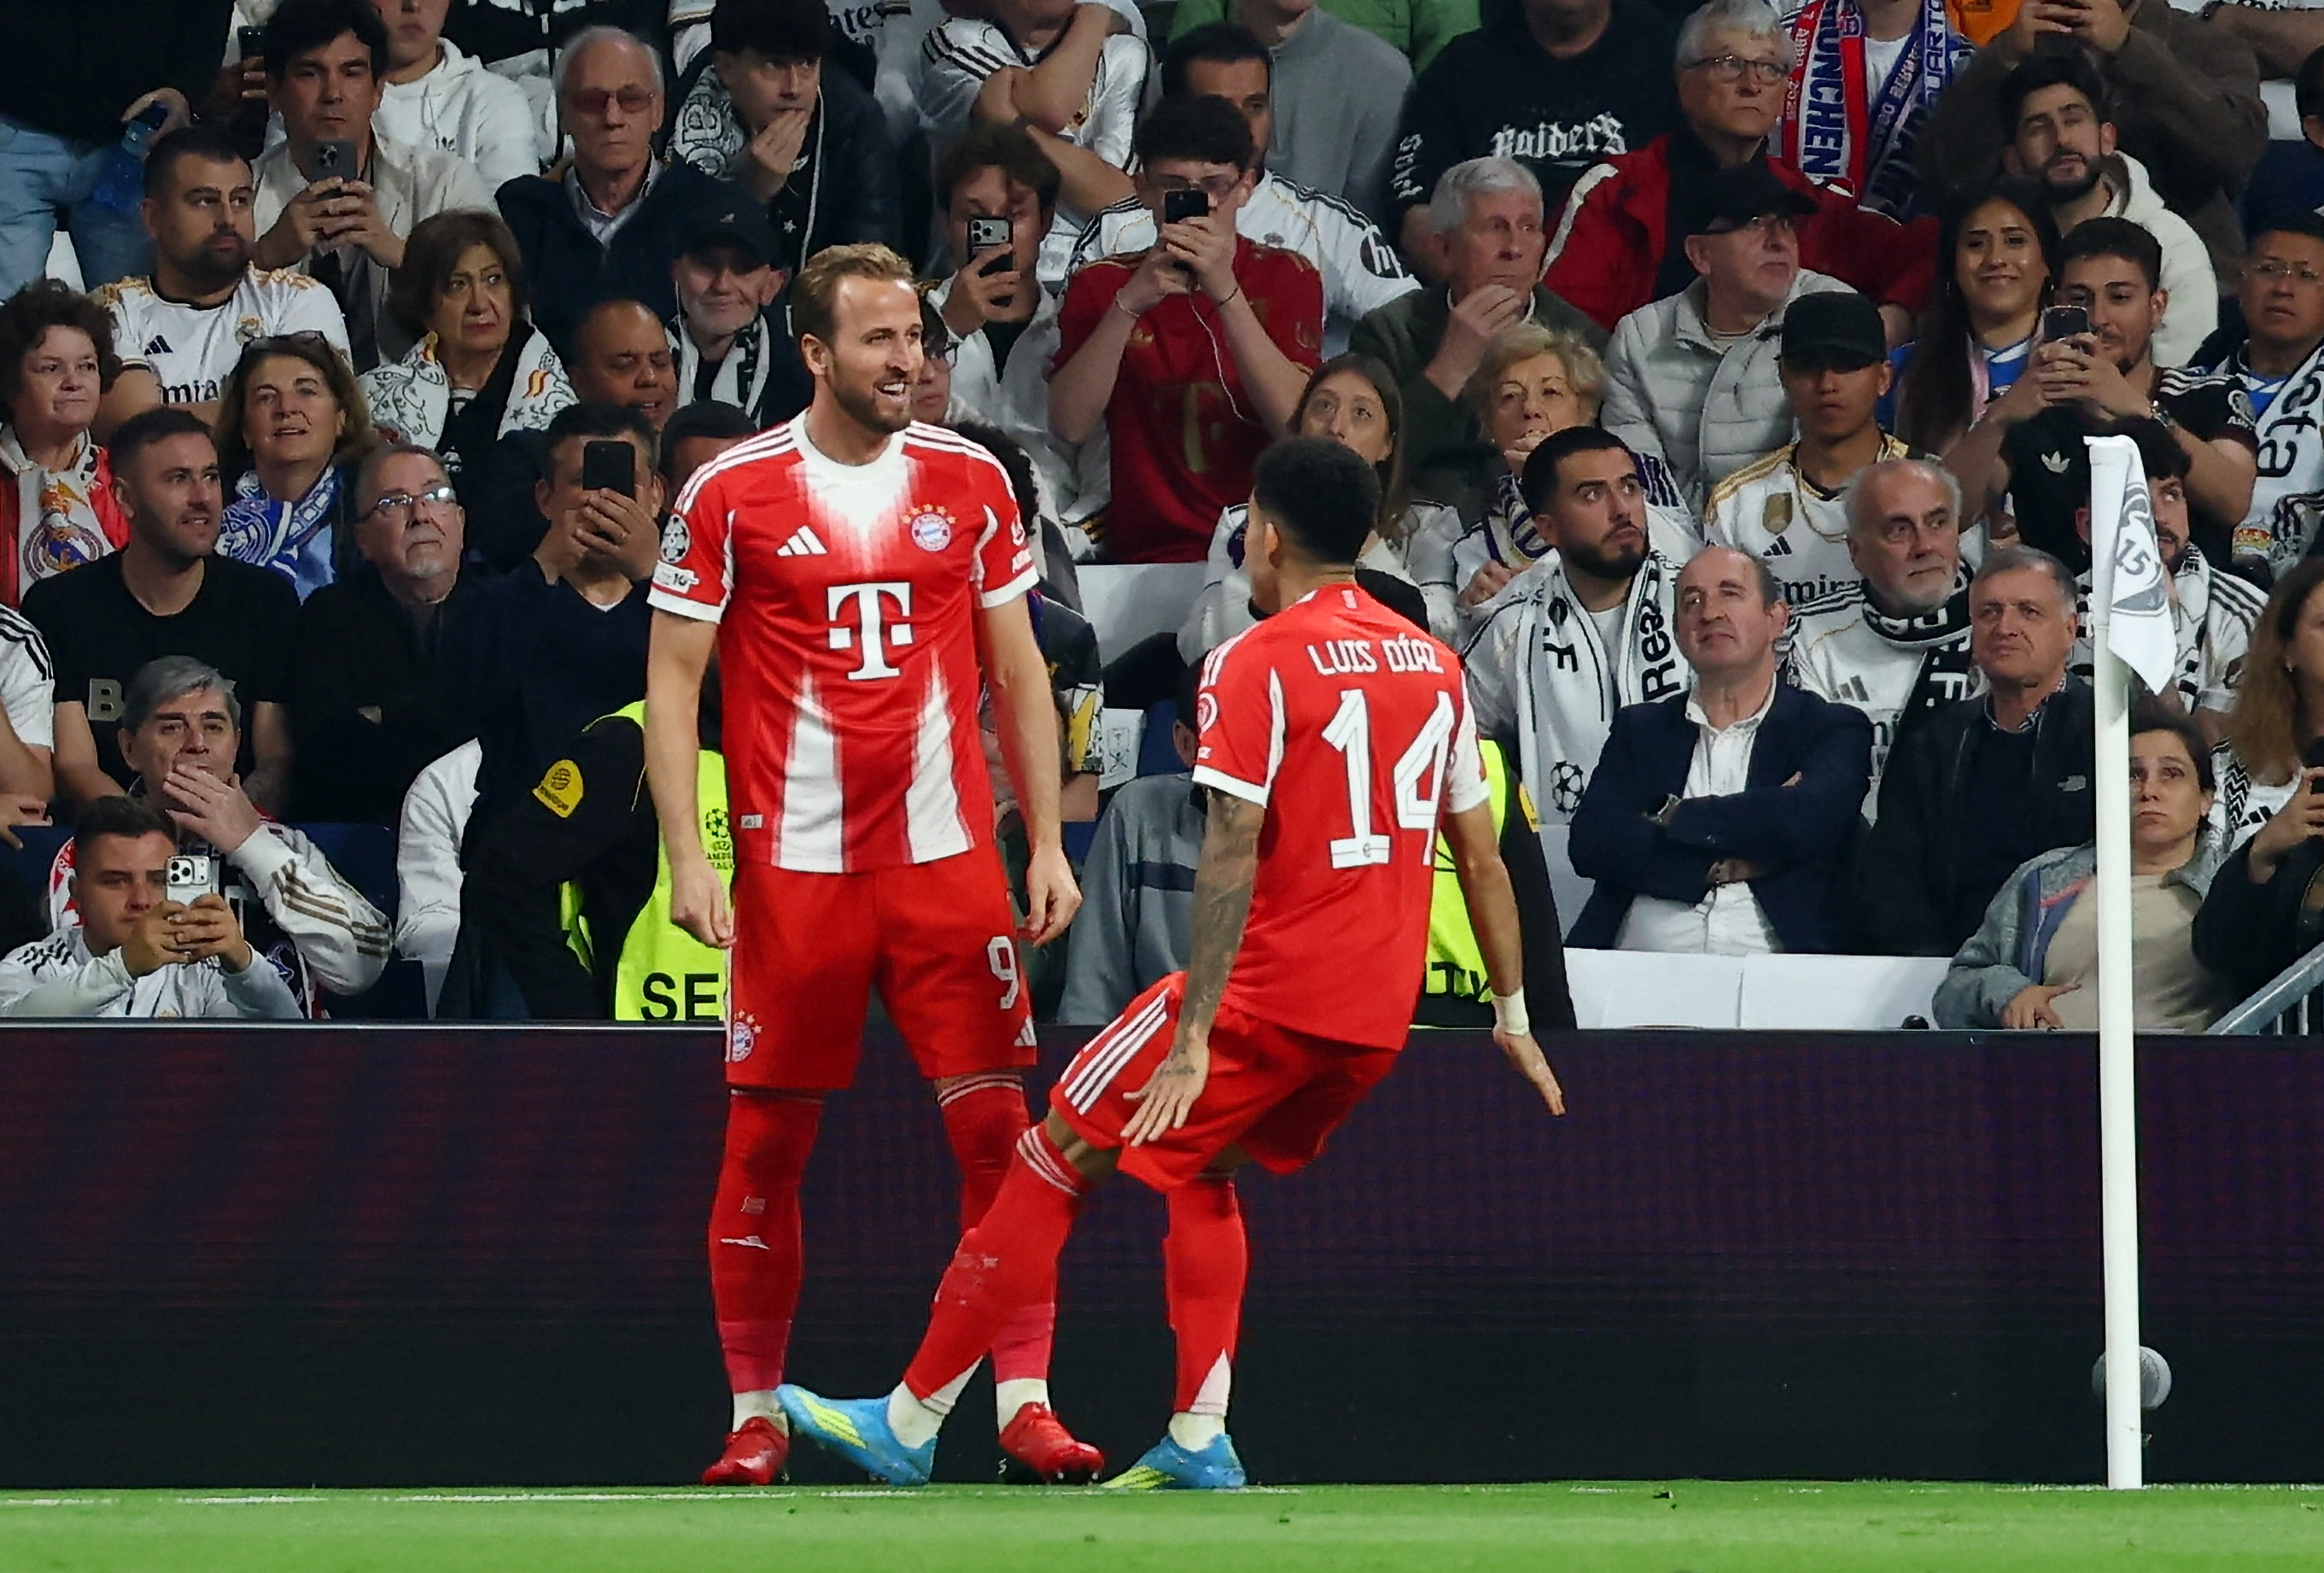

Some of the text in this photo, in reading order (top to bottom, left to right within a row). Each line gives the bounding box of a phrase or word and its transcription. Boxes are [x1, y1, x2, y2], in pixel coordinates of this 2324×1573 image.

[2115, 538, 2151, 576] 15
[826, 582, 914, 681] T
[1306, 632, 1445, 675] LUIS DÍAZ
[1321, 688, 1455, 869] 14
[640, 972, 722, 1021] SE
[987, 935, 1019, 1009] 9
[1431, 961, 1490, 1003] TY
